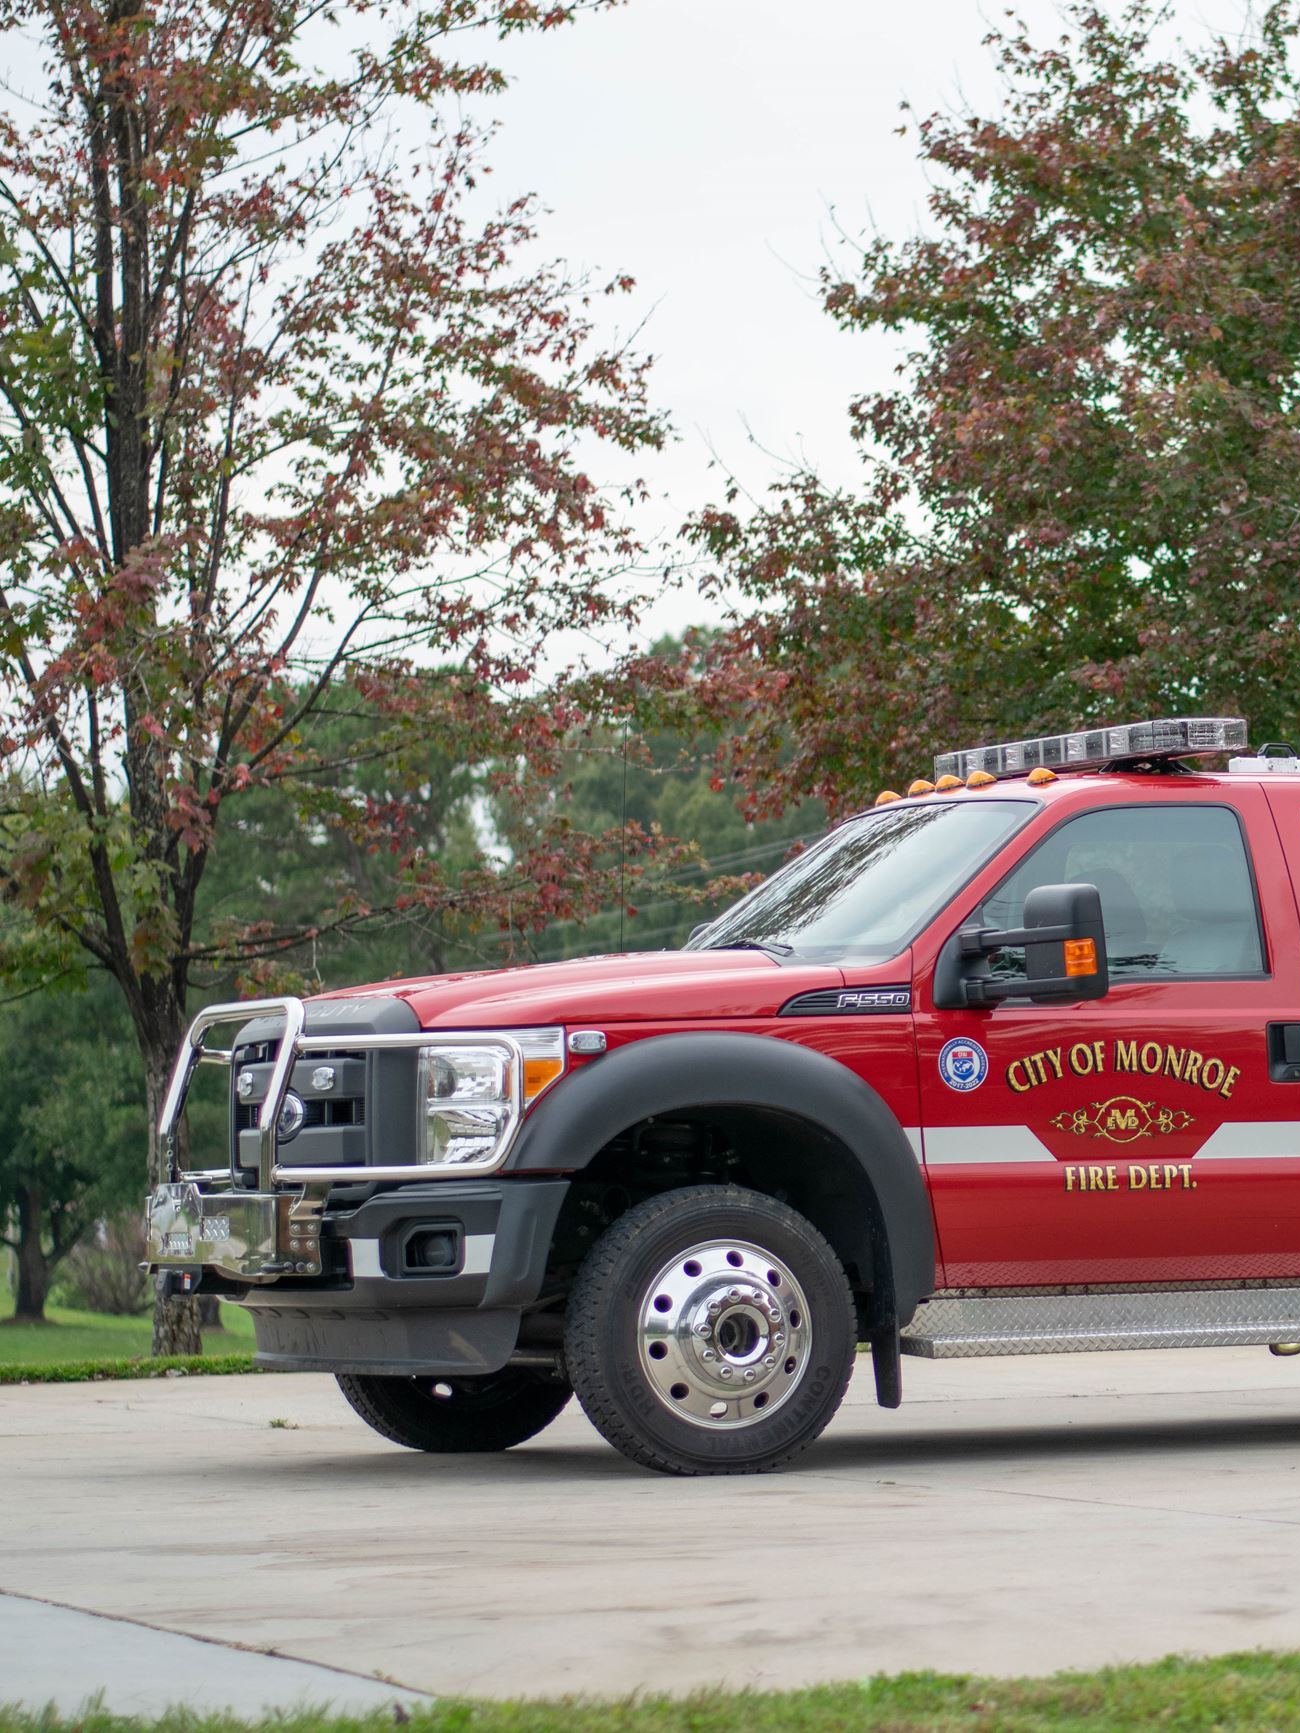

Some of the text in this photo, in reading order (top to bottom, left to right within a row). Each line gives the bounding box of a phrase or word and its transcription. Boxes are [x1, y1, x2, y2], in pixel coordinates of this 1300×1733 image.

[837, 993, 910, 1008] F-550
[1006, 1040, 1240, 1099] CITY OF MONROE
[948, 1078, 979, 1089] 2017-2022
[1064, 1164, 1197, 1192] FIRE DEPT.
